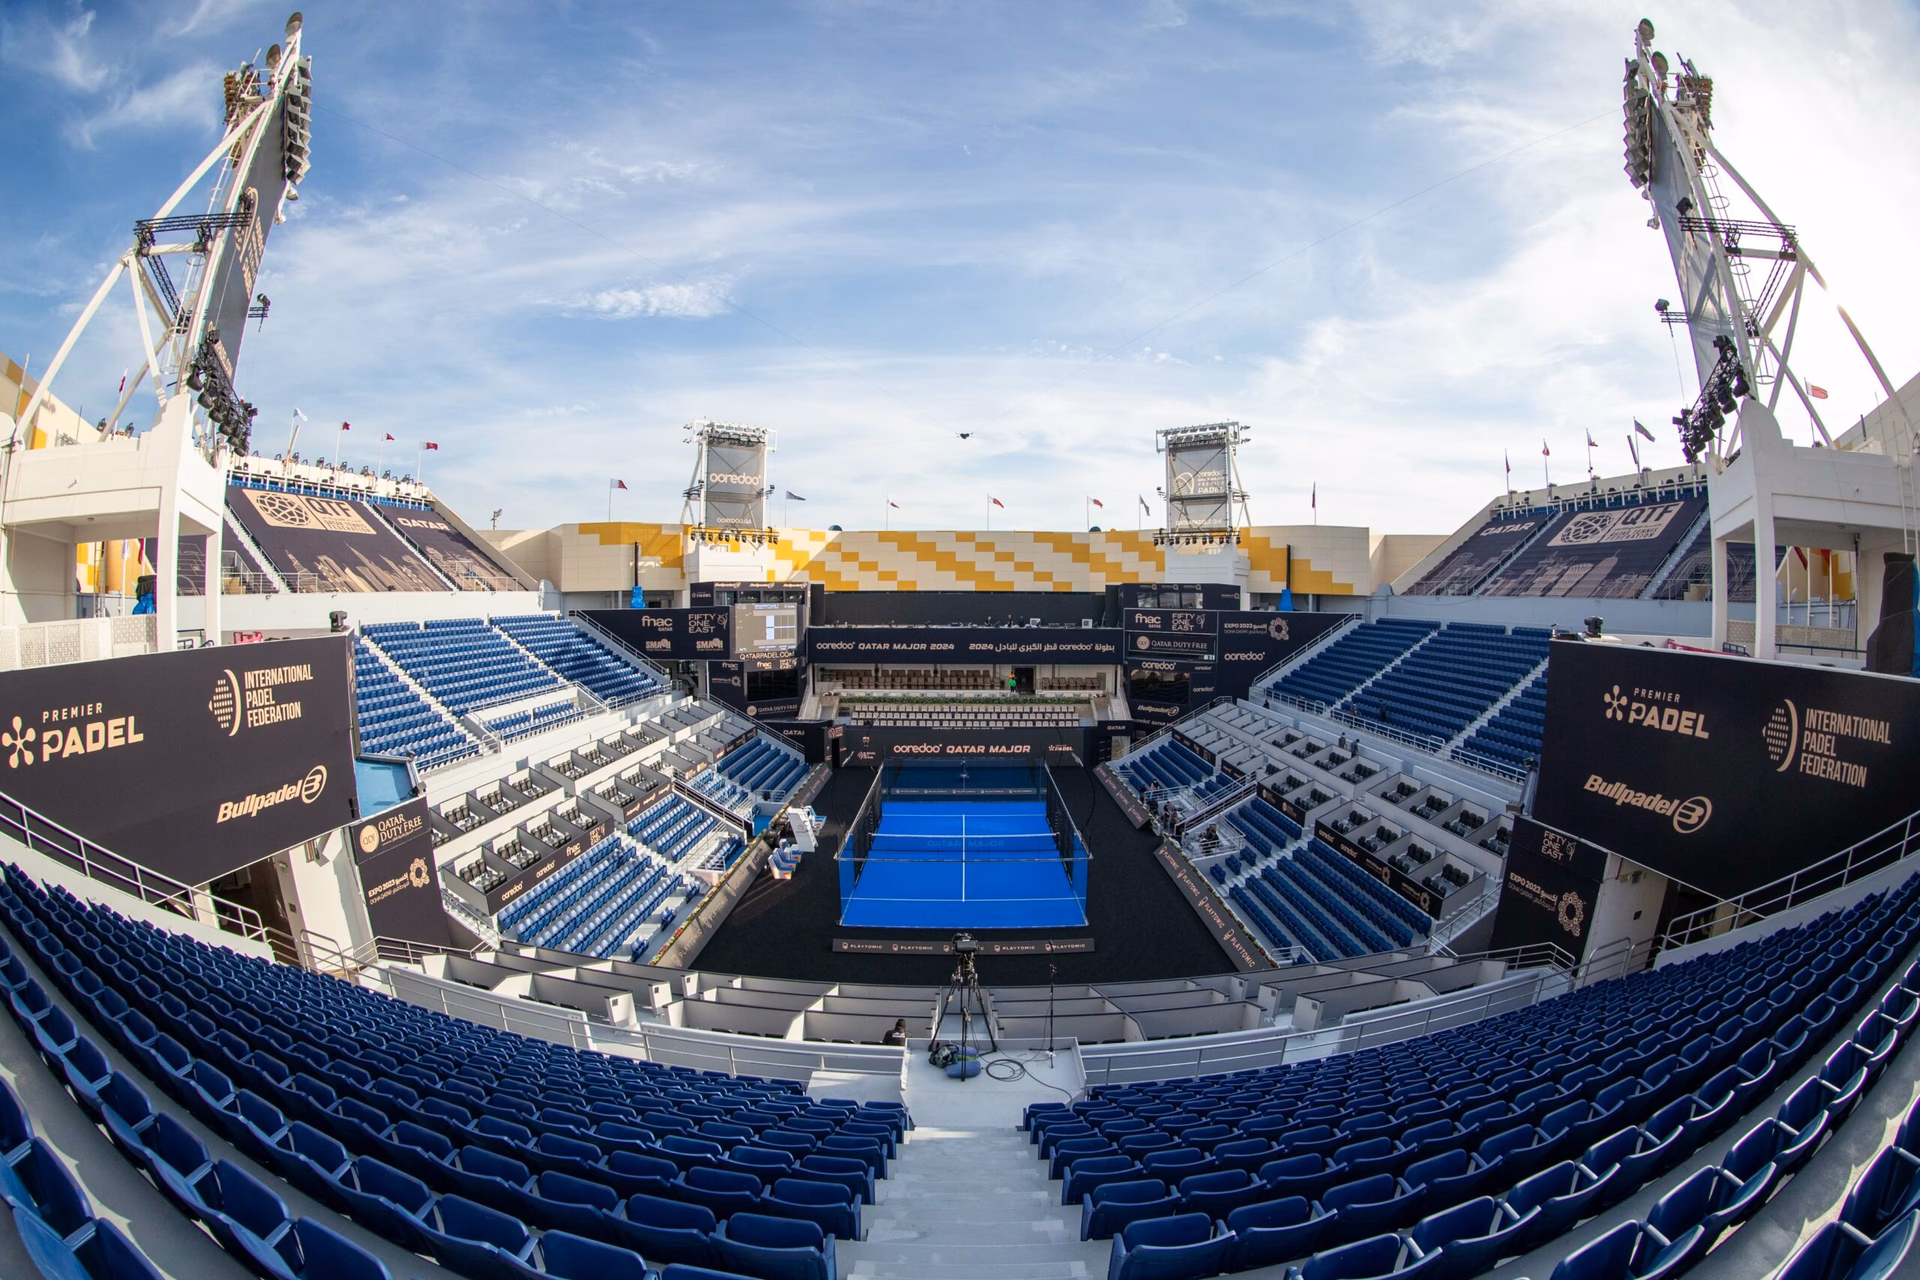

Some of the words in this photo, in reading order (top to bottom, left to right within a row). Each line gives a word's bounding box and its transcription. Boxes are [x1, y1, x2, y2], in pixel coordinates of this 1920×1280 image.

[710, 472, 761, 485] ooredoo
[305, 498, 351, 517] QTF
[1622, 503, 1679, 525] QTF
[398, 517, 450, 531] QATAR
[1480, 522, 1535, 536] QATAR
[642, 615, 673, 627] fnac
[1135, 613, 1161, 624] fnac
[816, 641, 855, 650] ooredoo
[1044, 643, 1057, 652] قطر
[1095, 643, 1115, 652] بطولة
[1152, 640, 1172, 648] QATAR
[1225, 651, 1265, 661] ooredoo
[1142, 662, 1176, 670] ooredoo
[244, 663, 314, 690] INTERNATIONAL
[246, 688, 276, 708] PADEL
[1633, 687, 1681, 703] PREMIER
[42, 702, 103, 723] PREMIER
[247, 701, 302, 728] FEDERATION
[1138, 705, 1169, 713] Bullpadel
[1628, 703, 1710, 739] PADEL
[1805, 708, 1891, 744] INTERNATIONAL
[41, 715, 144, 762] PADEL
[1802, 731, 1837, 757] PADEL
[893, 743, 942, 754] ooredoo
[946, 745, 985, 754] QATAR
[988, 745, 1031, 754] MAJOR
[1799, 756, 1868, 788] FEDERATION
[216, 779, 304, 823] Bullpadel
[1584, 774, 1681, 817] Bullpadel
[378, 813, 405, 831] QATAR
[380, 826, 404, 843] DUTY
[404, 815, 422, 831] FREE
[1542, 839, 1560, 851] ONE
[1544, 831, 1567, 844] FIFTY
[1541, 846, 1563, 861] EAST
[536, 860, 555, 878] ooredoo
[368, 885, 382, 898] EXPO
[382, 878, 395, 891] 2023
[502, 881, 523, 901] ooredoo
[1182, 874, 1200, 897] PLAYTOMIC
[1510, 872, 1526, 886] EXPO
[1526, 880, 1541, 893] 2023
[1204, 902, 1226, 929] PLAYTOMIC
[679, 929, 703, 959] PLAYTOMIC
[1230, 937, 1256, 968] PLAYTOMIC
